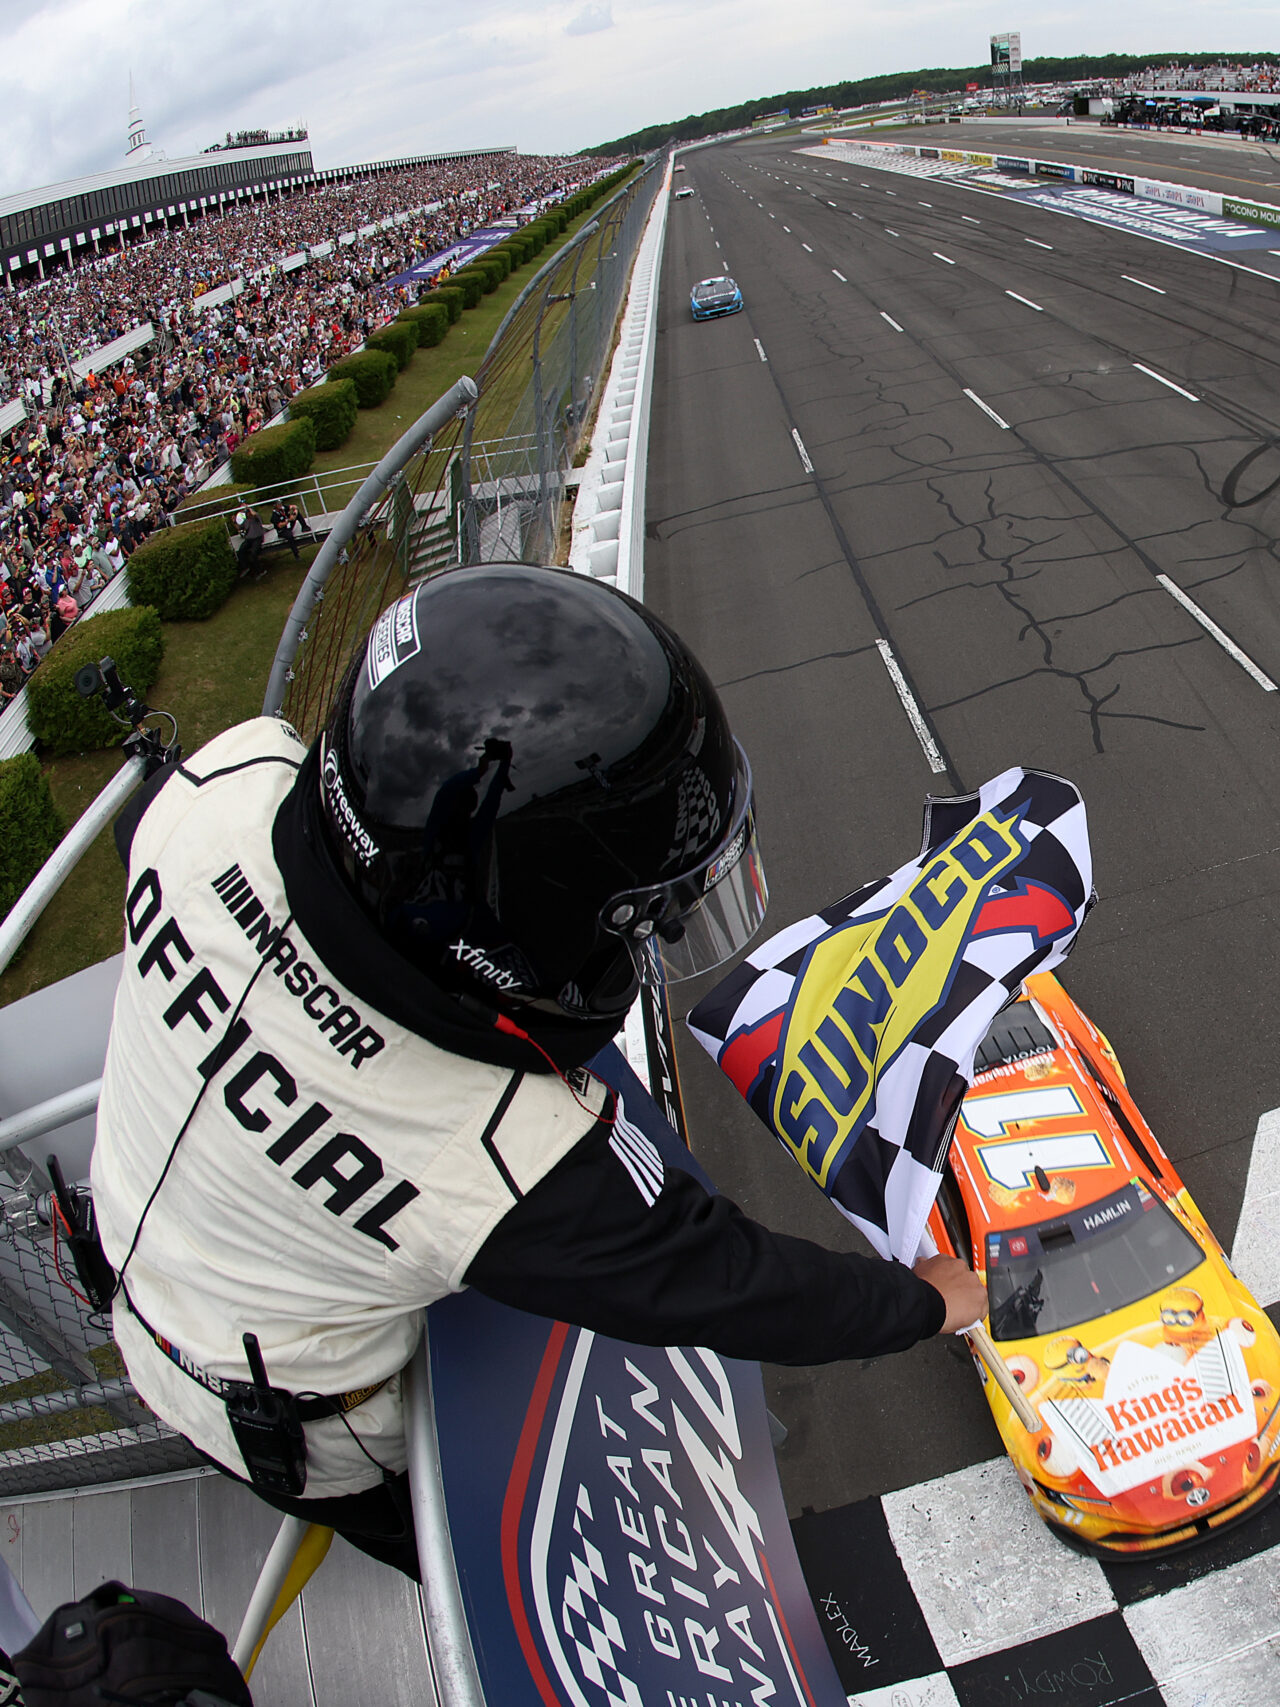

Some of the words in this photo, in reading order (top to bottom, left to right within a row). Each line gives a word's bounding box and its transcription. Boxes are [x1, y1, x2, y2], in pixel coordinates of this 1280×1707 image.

[1226, 202, 1259, 219] POCONO
[377, 616, 392, 664] SERIES
[328, 791, 373, 869] INSURANCE
[332, 775, 380, 859] Freeway
[246, 910, 387, 1071] NASCAR
[450, 937, 523, 994] xfinity
[779, 815, 1013, 1175] SUNOCO
[125, 866, 421, 1252] OFFICIAL
[1002, 1044, 1055, 1066] TOYOTA
[959, 1083, 1117, 1192] 11
[1082, 1199, 1132, 1231] HAMLIN
[1088, 1393, 1245, 1473] Hawaiian
[1104, 1375, 1204, 1433] King's
[595, 1393, 682, 1660] GREAT
[818, 1592, 881, 1669] MADLEX
